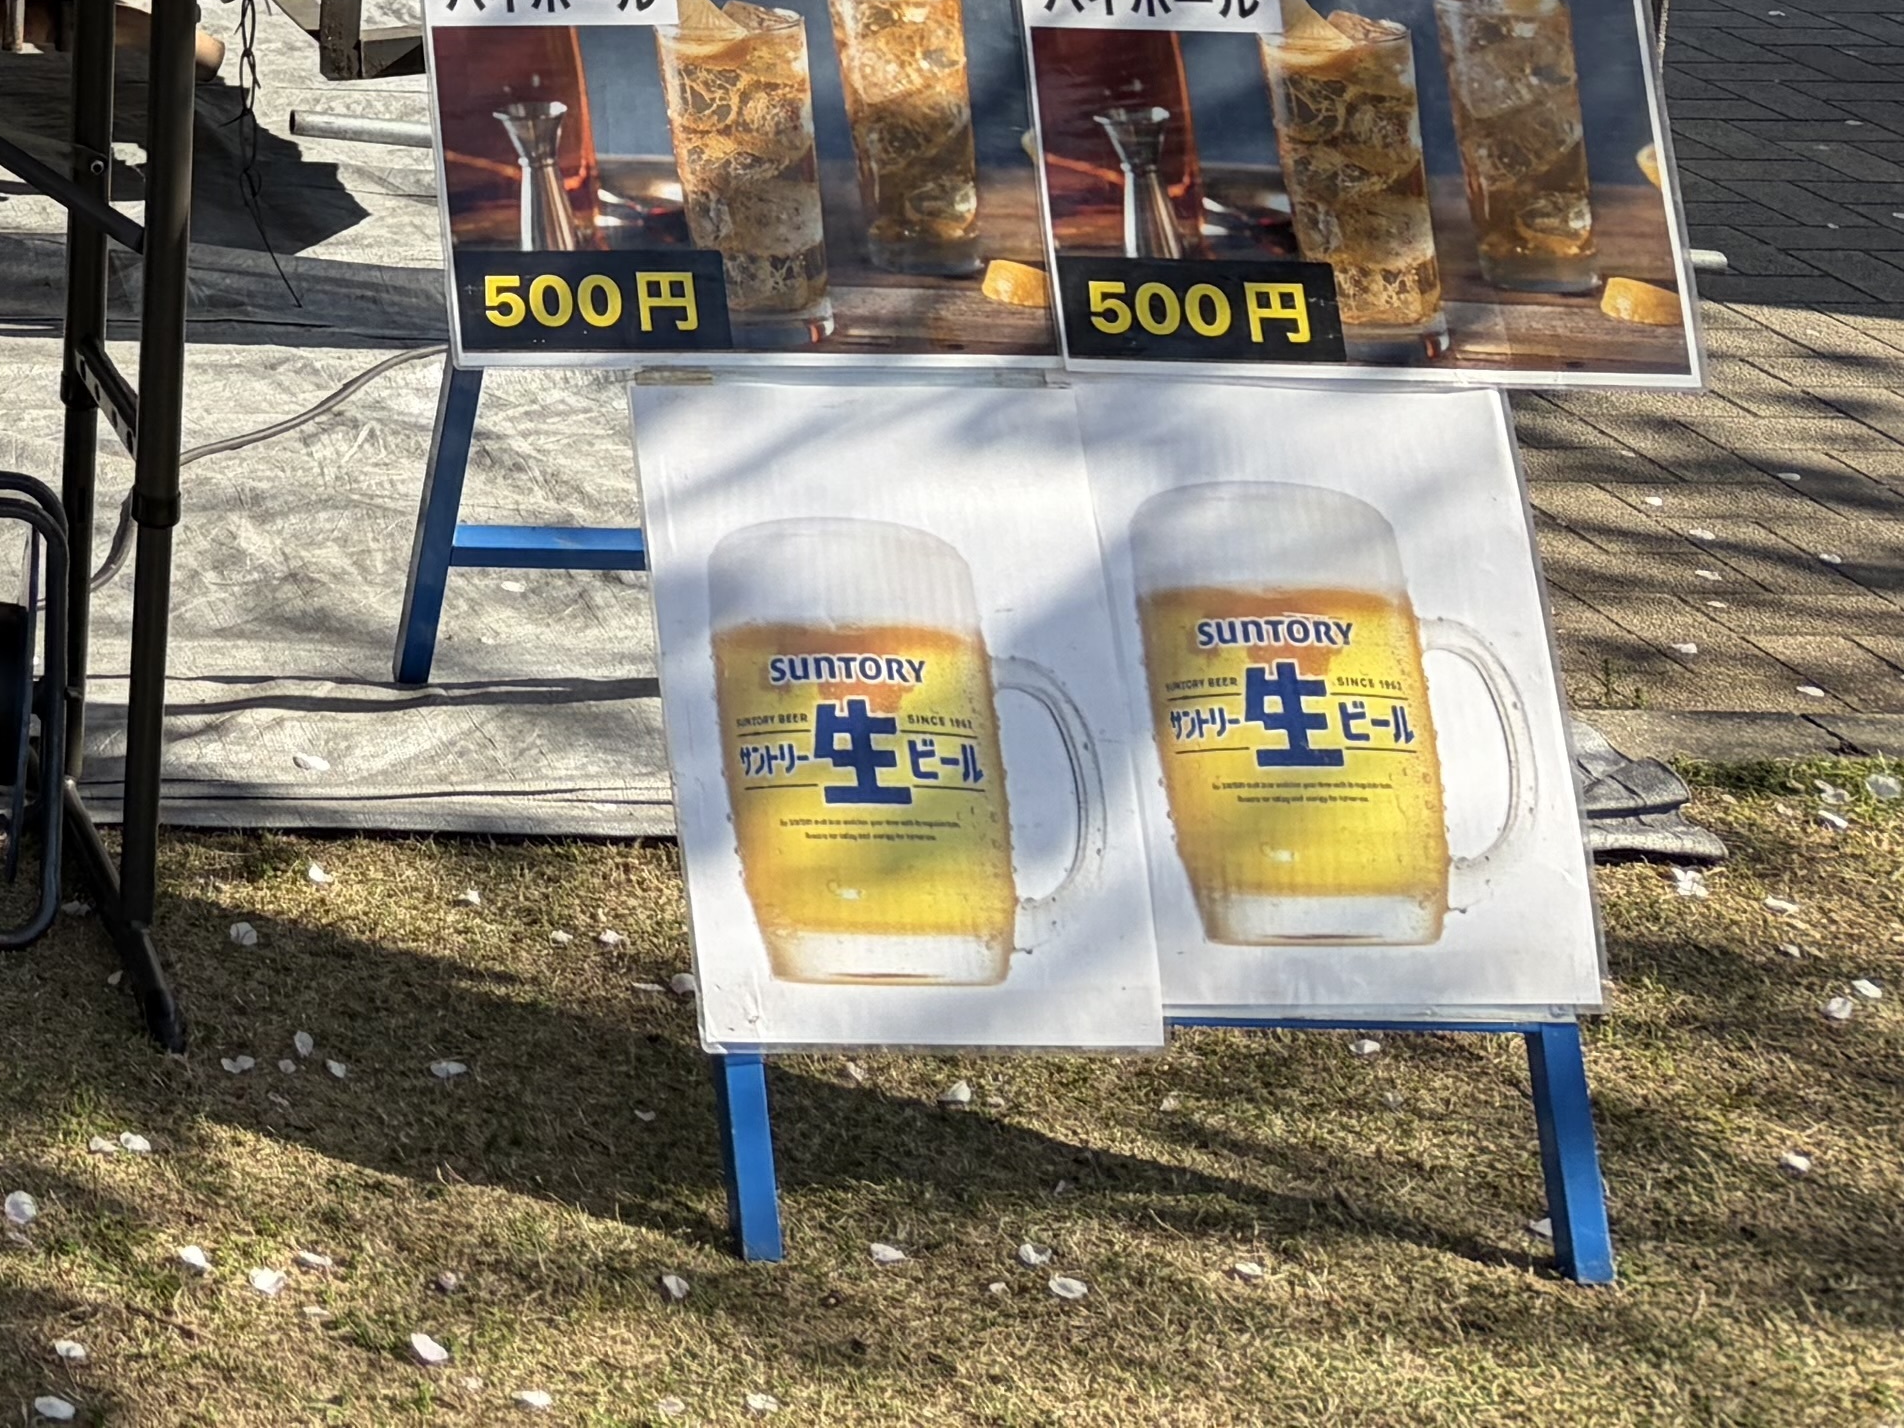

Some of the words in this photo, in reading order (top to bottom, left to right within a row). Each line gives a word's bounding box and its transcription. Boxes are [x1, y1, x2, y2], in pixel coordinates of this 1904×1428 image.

[483, 270, 700, 333] 500円
[1087, 279, 1313, 343] 500円
[1197, 617, 1353, 647] SUNTORY
[770, 655, 926, 684] SUNTORY
[1209, 676, 1238, 688] BEER
[1336, 676, 1375, 689] SINCE
[779, 713, 809, 724] BEER
[907, 713, 945, 727] SINCE
[1169, 707, 1240, 739] サントリー
[1244, 661, 1344, 768] 生
[1338, 701, 1414, 745] ビール
[739, 743, 810, 777] サントリー
[814, 698, 913, 805] 生
[908, 739, 984, 783] ビール
